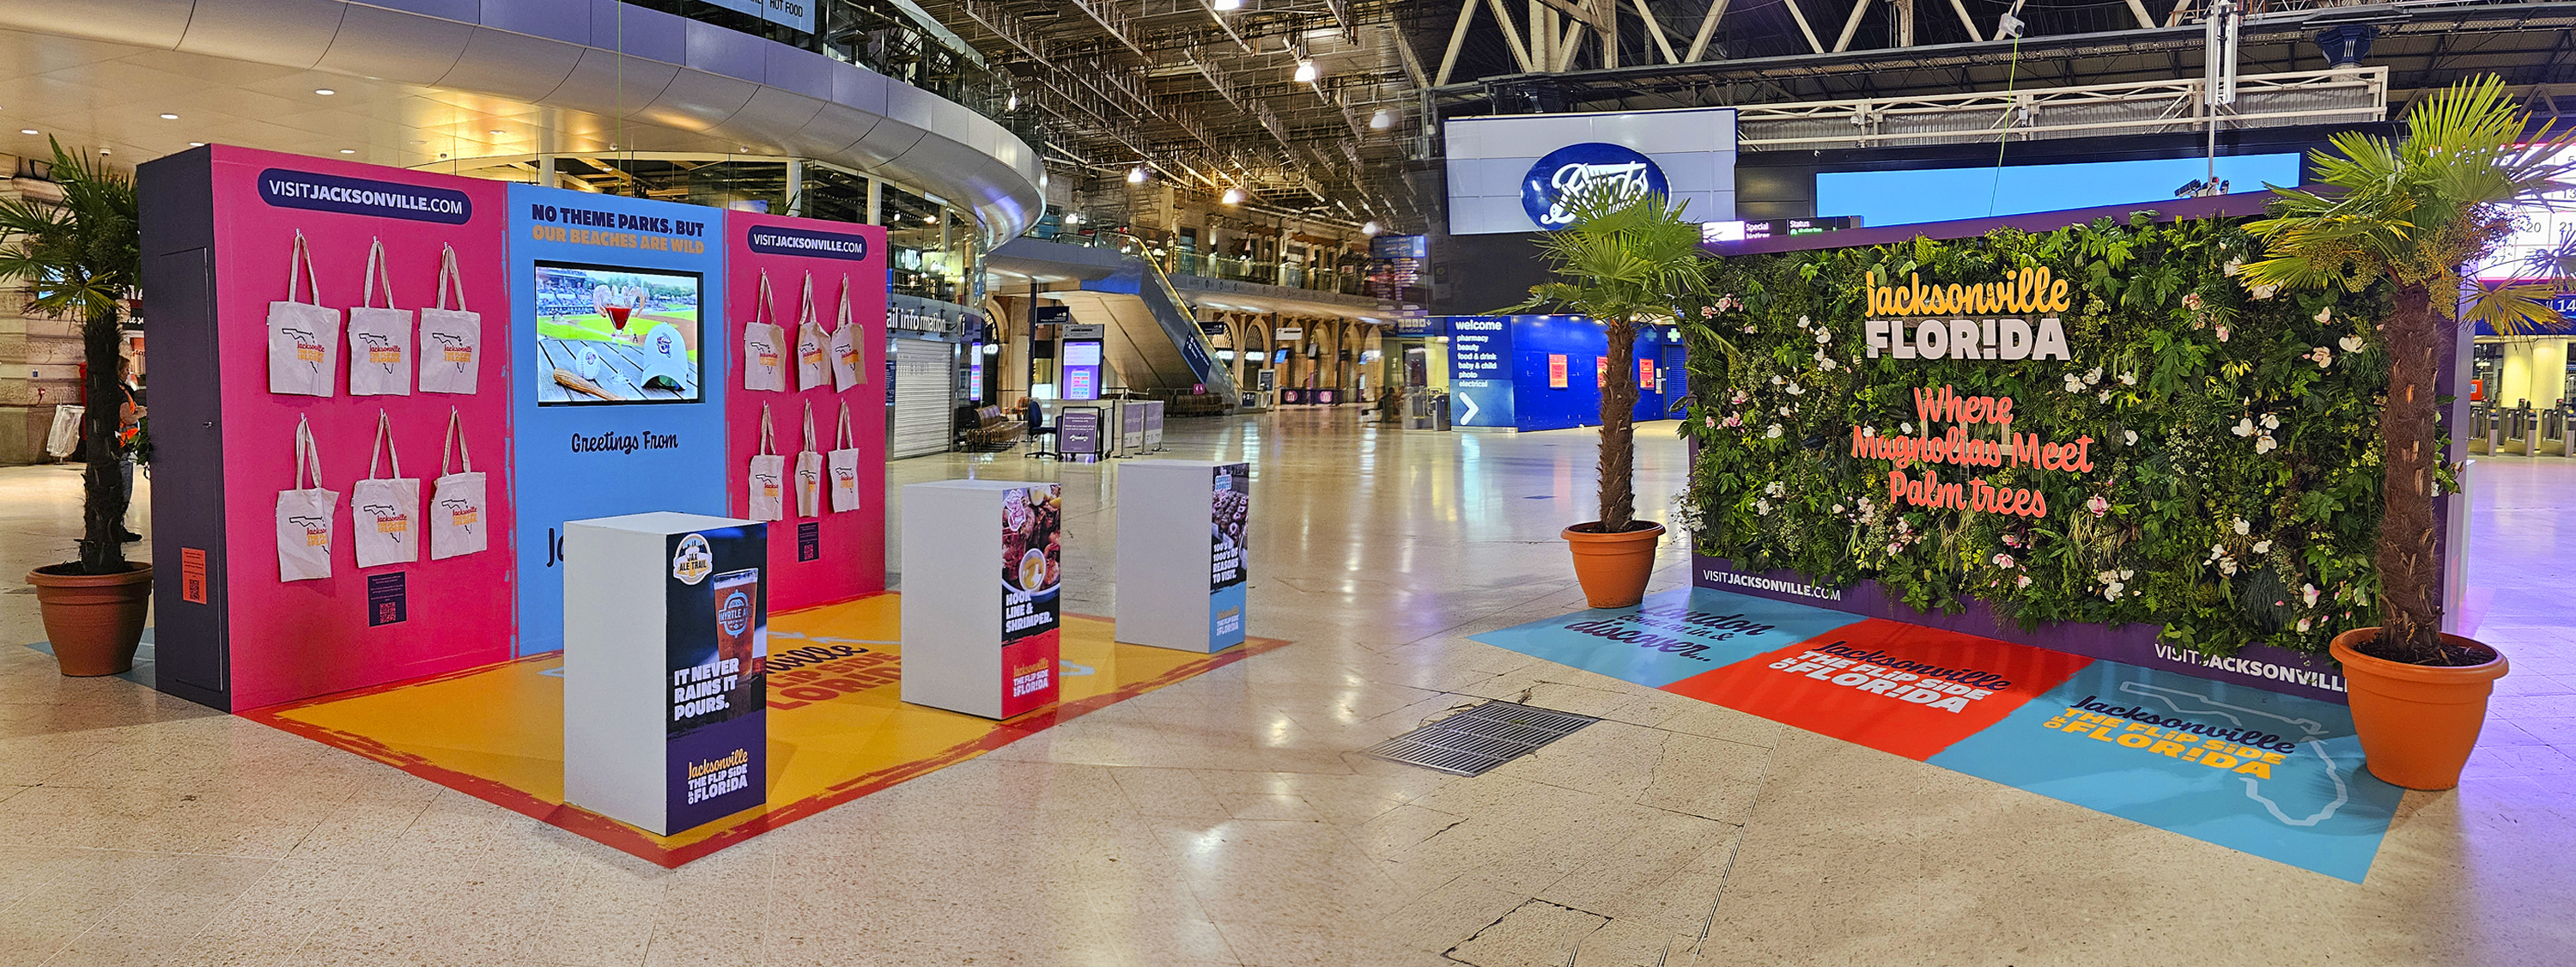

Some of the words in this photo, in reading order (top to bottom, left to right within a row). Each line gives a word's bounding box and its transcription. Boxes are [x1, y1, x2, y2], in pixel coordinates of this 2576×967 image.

[785, 2, 803, 17] FOOD
[269, 179, 462, 215] VISITJACKSONVILLE.COM
[532, 204, 556, 222] NO
[560, 207, 615, 228] THEME
[618, 214, 672, 234] PARKS,
[676, 221, 704, 237] BUT
[1746, 222, 1769, 232] Special
[2526, 222, 2541, 233] 20
[532, 224, 567, 242] OUR
[570, 228, 637, 249] BEACHES
[640, 234, 668, 252] ARE
[670, 239, 705, 254] WILD
[754, 234, 862, 253] VISITJACKSONVILLE.COM
[1865, 266, 2070, 317] Jacksonville
[886, 307, 898, 329] ail
[901, 308, 945, 332] information
[1455, 319, 1503, 330] welcome
[1456, 334, 1489, 343] pharmacy
[1457, 344, 1479, 352] beauty
[1458, 362, 1474, 370] baby
[1913, 383, 2014, 425] Where
[571, 431, 639, 454] Greetings
[642, 431, 678, 449] From
[1852, 425, 2002, 469] Magnolias
[2011, 432, 2094, 472] Meet
[1888, 470, 1967, 511] Palm
[1968, 476, 2046, 518] trees
[680, 563, 690, 571] ALE
[692, 560, 706, 569] TRAIL
[688, 553, 697, 562] JAX
[1212, 557, 1239, 574] REASONS
[1212, 572, 1220, 584] TO
[1703, 569, 1841, 601] VISITJACKSONVILLE.COM
[1005, 590, 1031, 606] HOOK
[720, 609, 741, 621] MYRTLE
[1005, 605, 1025, 619] LINE
[1026, 603, 1033, 614] &
[1005, 611, 1053, 633] SHRIMPER.
[1637, 603, 1775, 636] London
[1618, 614, 1664, 627] come
[1665, 623, 1688, 633] on
[1686, 627, 1709, 637] in
[1709, 632, 1734, 641] &
[1796, 650, 1858, 669] THE
[1812, 641, 2011, 690] Jacksonville
[2154, 643, 2348, 693] VISITACKSONVILL
[674, 668, 690, 686] IT
[691, 658, 739, 682] NEVER
[1013, 676, 1024, 686] THE
[674, 678, 721, 703] RAINS
[724, 675, 738, 691] IT
[674, 694, 730, 721] POURS.
[2062, 707, 2122, 726] THE
[2069, 695, 2295, 754] Jacksonville
[688, 748, 748, 780] Jacksonville
[688, 775, 707, 790] THE
